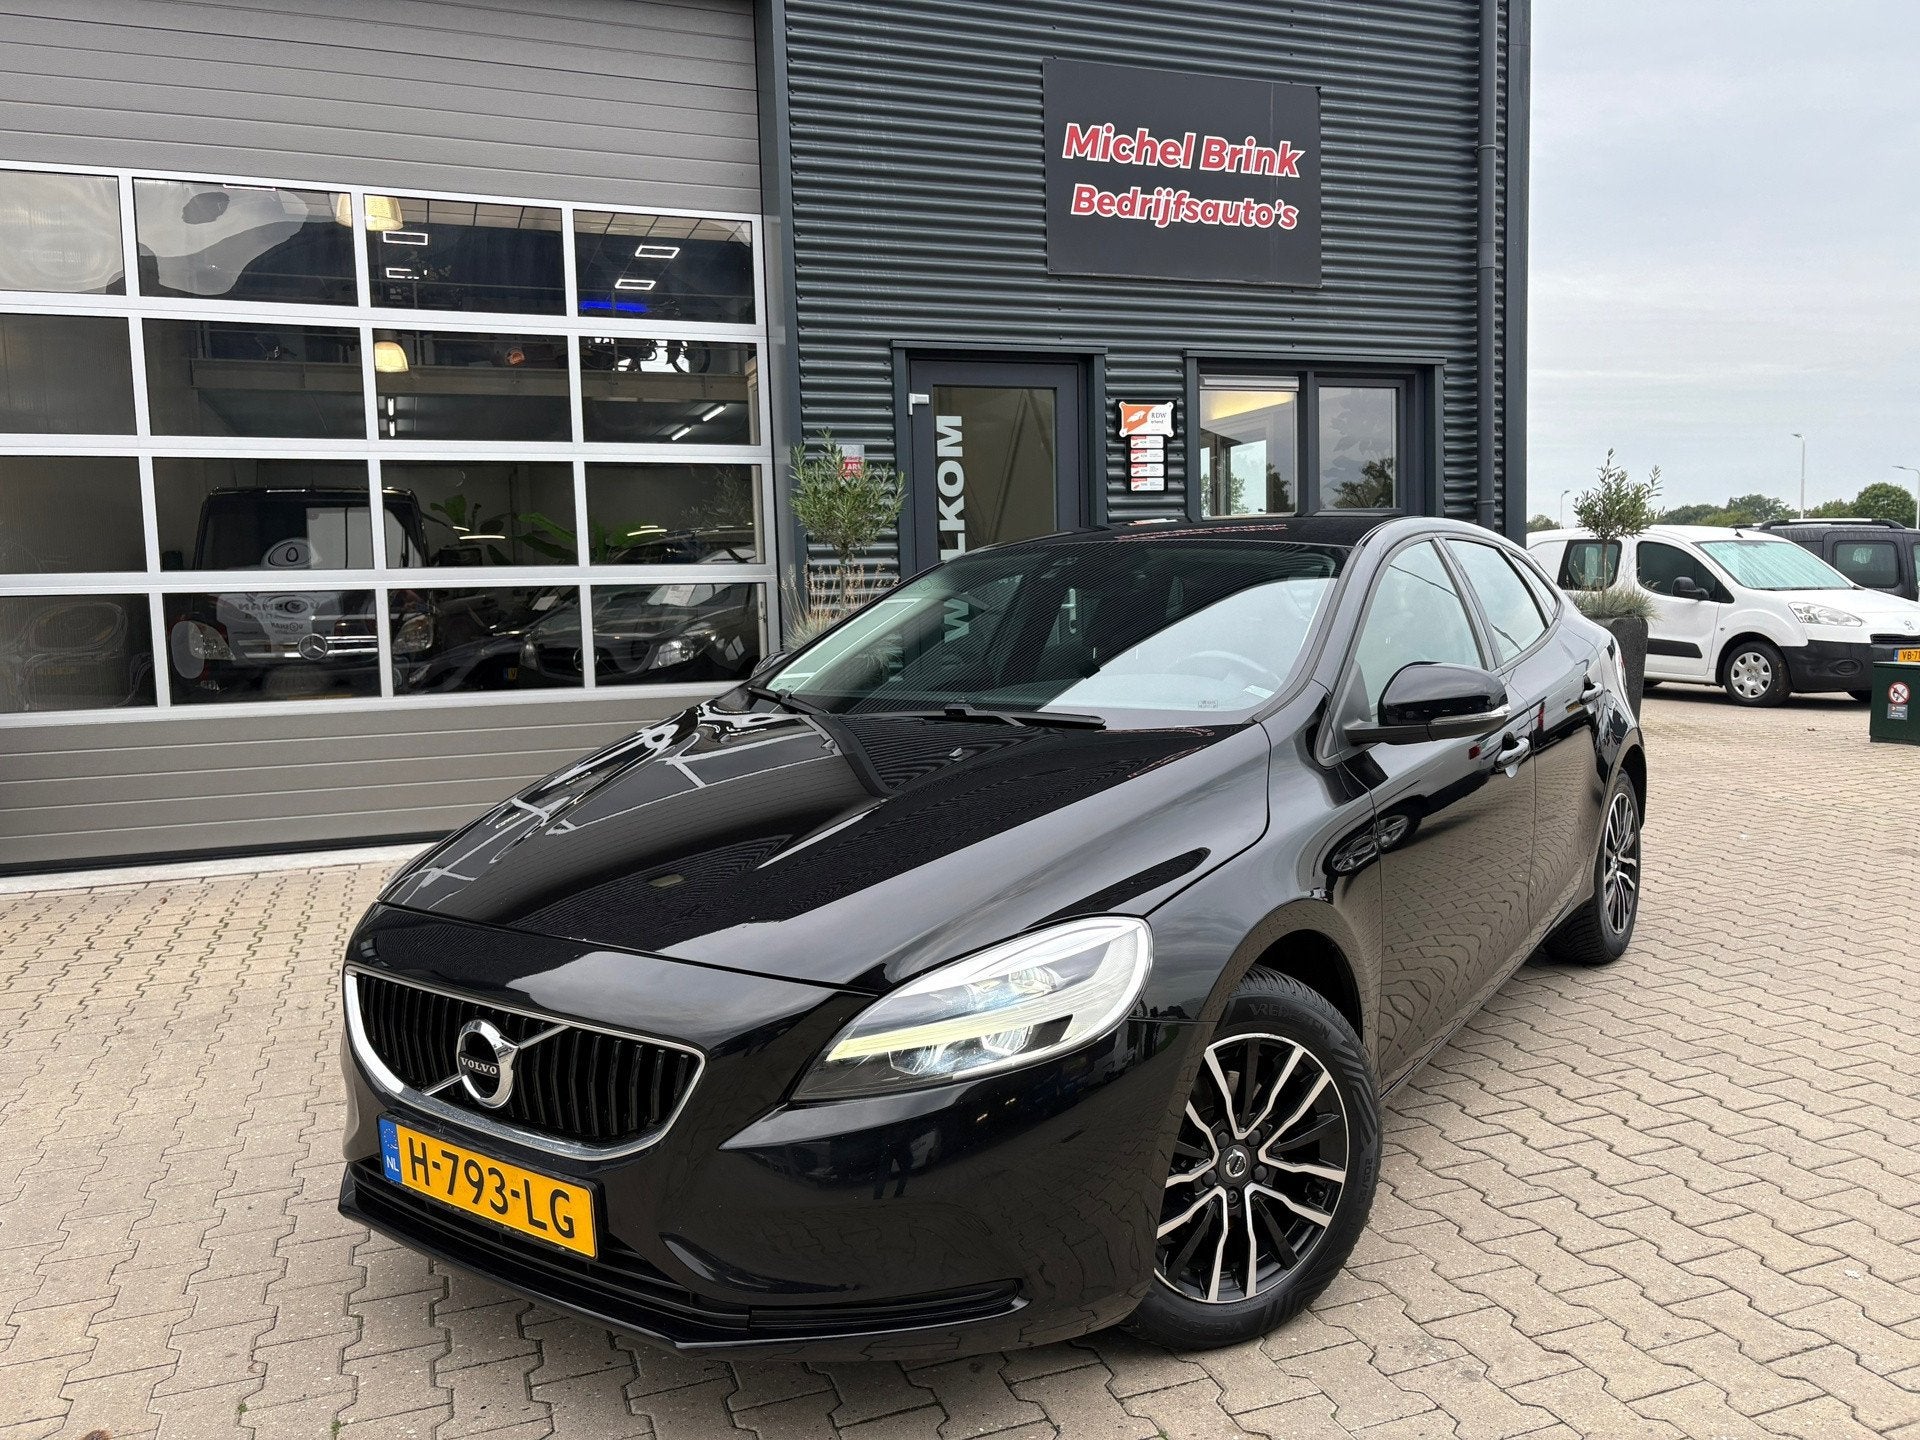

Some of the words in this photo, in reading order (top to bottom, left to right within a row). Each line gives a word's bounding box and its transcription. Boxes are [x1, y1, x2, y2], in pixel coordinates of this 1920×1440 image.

[1062, 123, 1196, 169] Michel
[1200, 135, 1305, 178] Brink
[1071, 183, 1299, 230] Bedrijfsauto's
[459, 1056, 498, 1075] VOLVO
[386, 1154, 400, 1172] NL
[408, 1137, 575, 1239] H-793-LG
